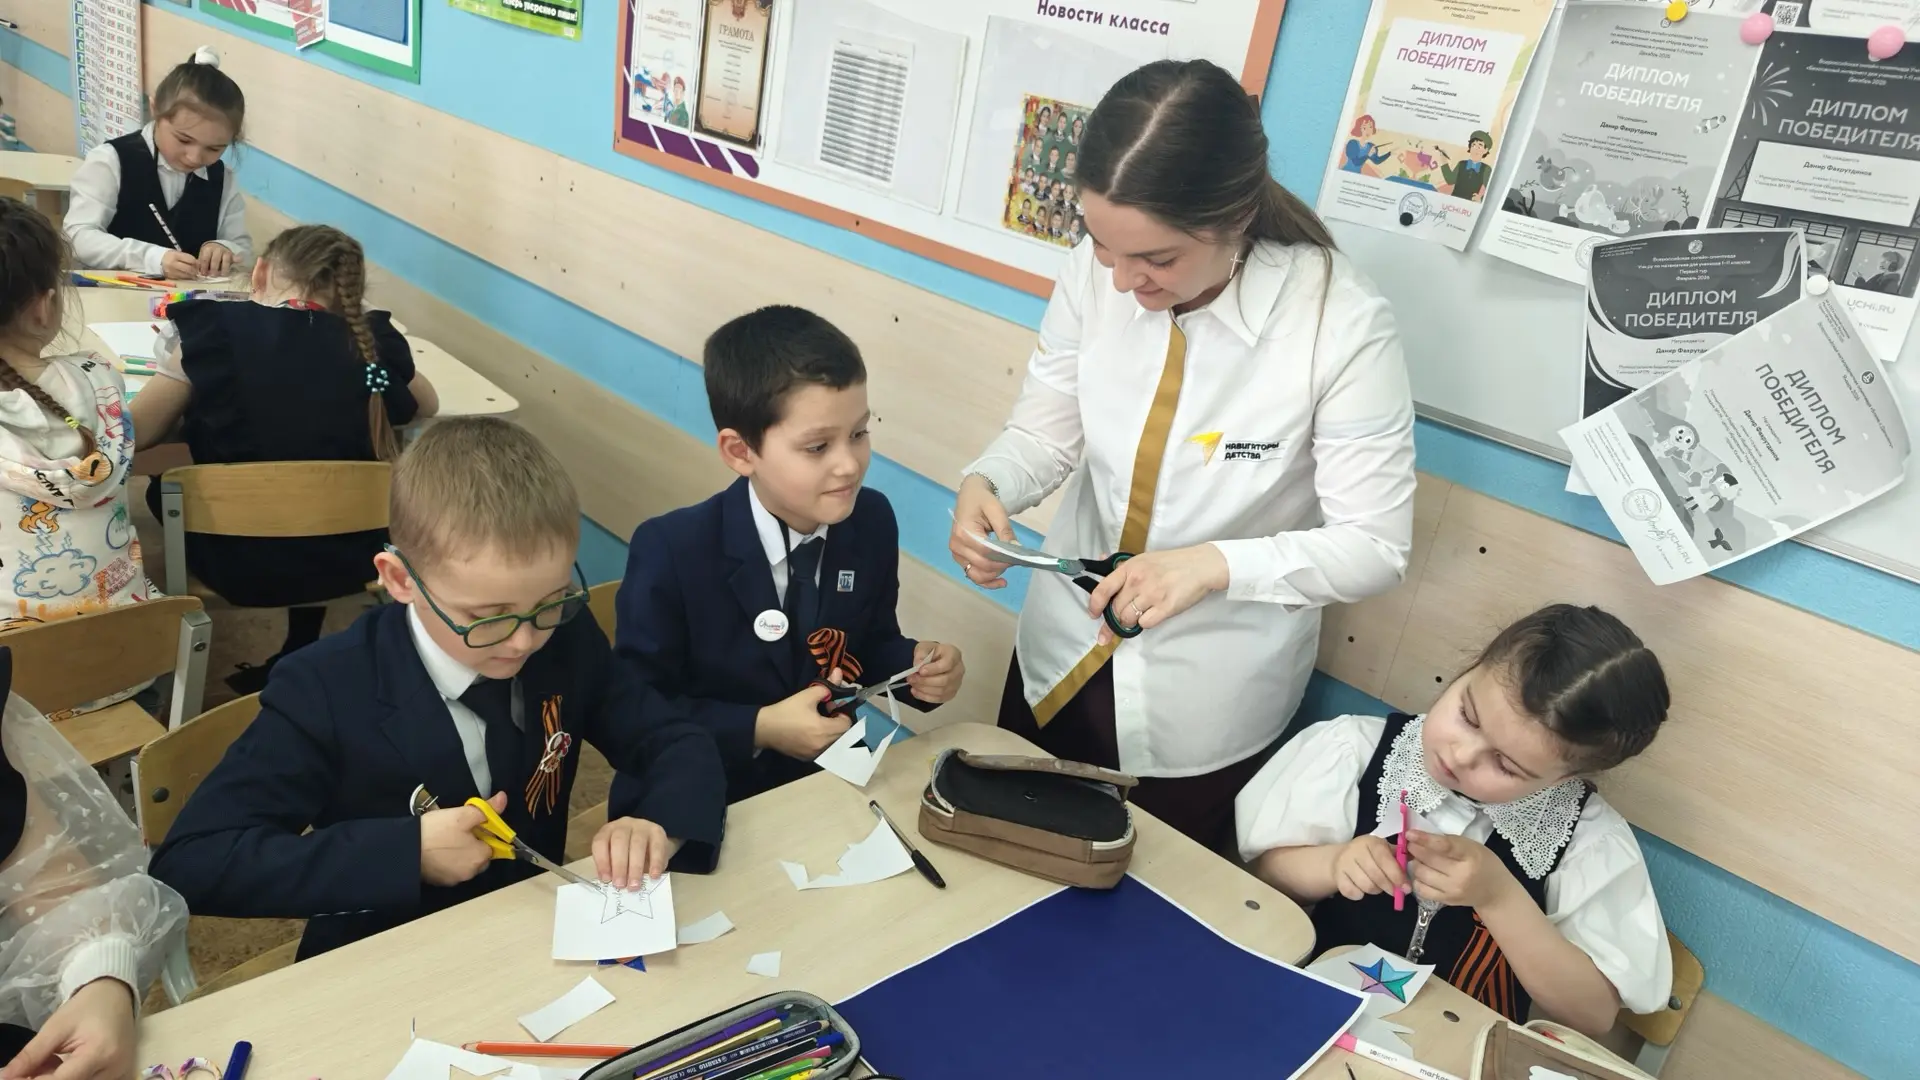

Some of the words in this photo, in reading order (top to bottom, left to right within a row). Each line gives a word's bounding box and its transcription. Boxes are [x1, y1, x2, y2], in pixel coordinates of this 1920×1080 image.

[1037, 0, 1103, 25] Новости
[1109, 14, 1170, 35] класса
[719, 24, 755, 42] ГРАМОТА
[1417, 30, 1488, 52] ДИПЛОМ
[1397, 47, 1496, 75] ПОБЕДИТЕЛЯ
[1604, 63, 1690, 88] ДИПЛОМ
[1580, 81, 1703, 113] ПОБЕДИТЕЛЯ
[1806, 99, 1909, 124] ДИПЛОМ
[1778, 119, 1920, 151] ПОБЕДИТЕЛЯ
[1646, 290, 1737, 309] ДИПЛОМ
[1625, 311, 1758, 329] ПОБЕДИТЕЛЯ
[1755, 363, 1836, 475] ПОБЕДИТЕЛЯ
[1784, 369, 1846, 445] ДИПЛОМ
[1225, 442, 1280, 451] НАВИГАТОРЫ
[1743, 409, 1758, 428] Данир
[1754, 425, 1780, 463] Фахрутдинов
[1225, 451, 1261, 461] ДЕТСТВА
[698, 1057, 722, 1071] STABILO
